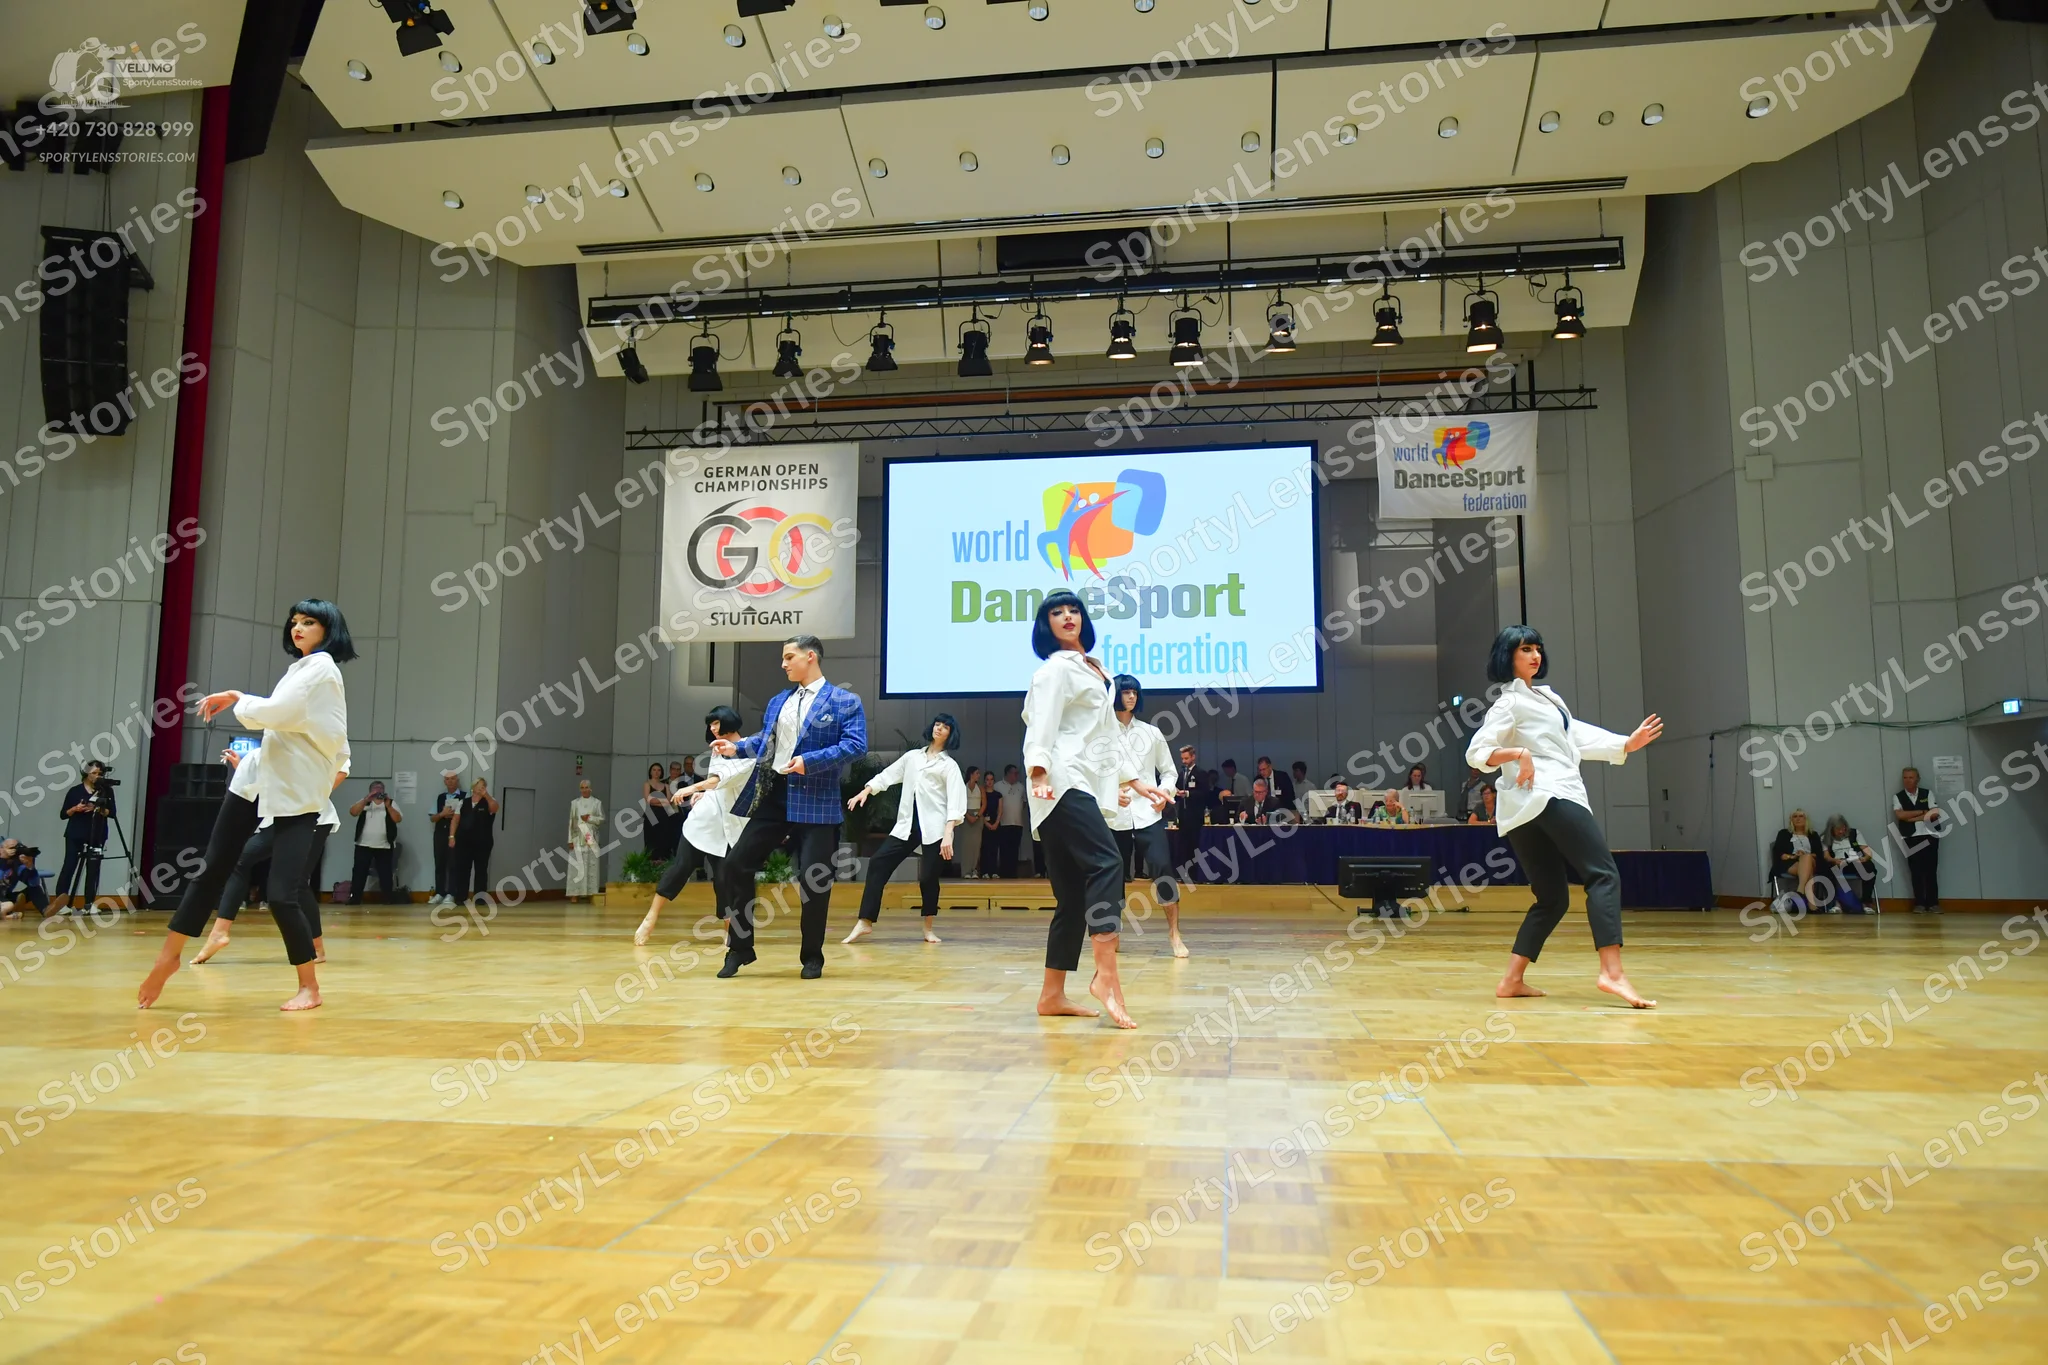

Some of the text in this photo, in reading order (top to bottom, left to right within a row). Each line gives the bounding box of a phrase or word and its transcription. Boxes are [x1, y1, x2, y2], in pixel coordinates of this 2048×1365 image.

[1393, 442, 1429, 462] world
[703, 463, 820, 478] GERMAN OPEN
[1394, 465, 1526, 491] DanceSport
[694, 477, 829, 493] CHAMPIONSHIPS
[1462, 492, 1527, 512] federation
[951, 520, 1030, 563] world
[951, 573, 1246, 628] DaneSport
[710, 606, 804, 626] STUTTGART
[1101, 632, 1248, 675] federation
